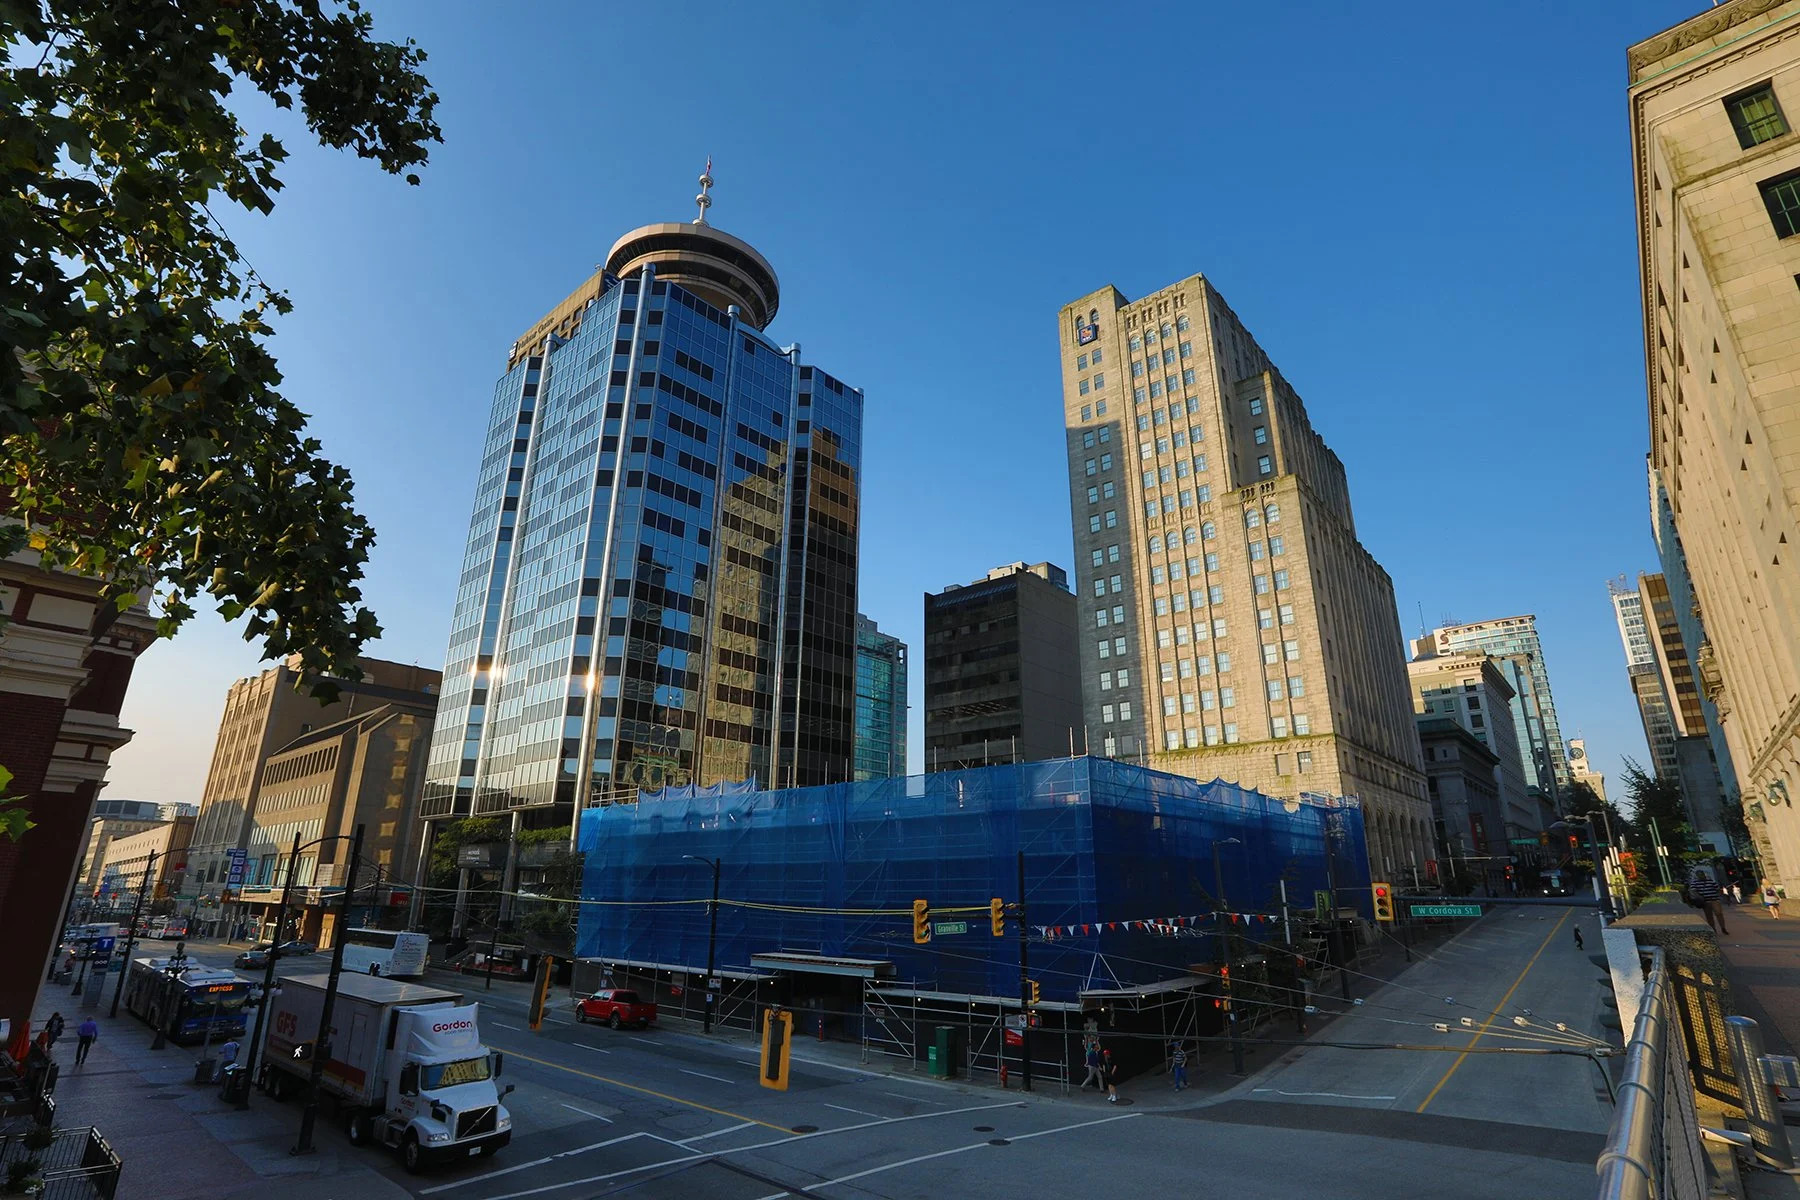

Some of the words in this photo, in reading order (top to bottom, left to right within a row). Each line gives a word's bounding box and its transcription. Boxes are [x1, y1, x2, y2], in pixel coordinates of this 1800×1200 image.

[1418, 907, 1426, 915] W
[1429, 907, 1462, 915] Cordova
[1465, 906, 1473, 915] St
[937, 925, 958, 933] Granville
[432, 1020, 473, 1033] Gordon
